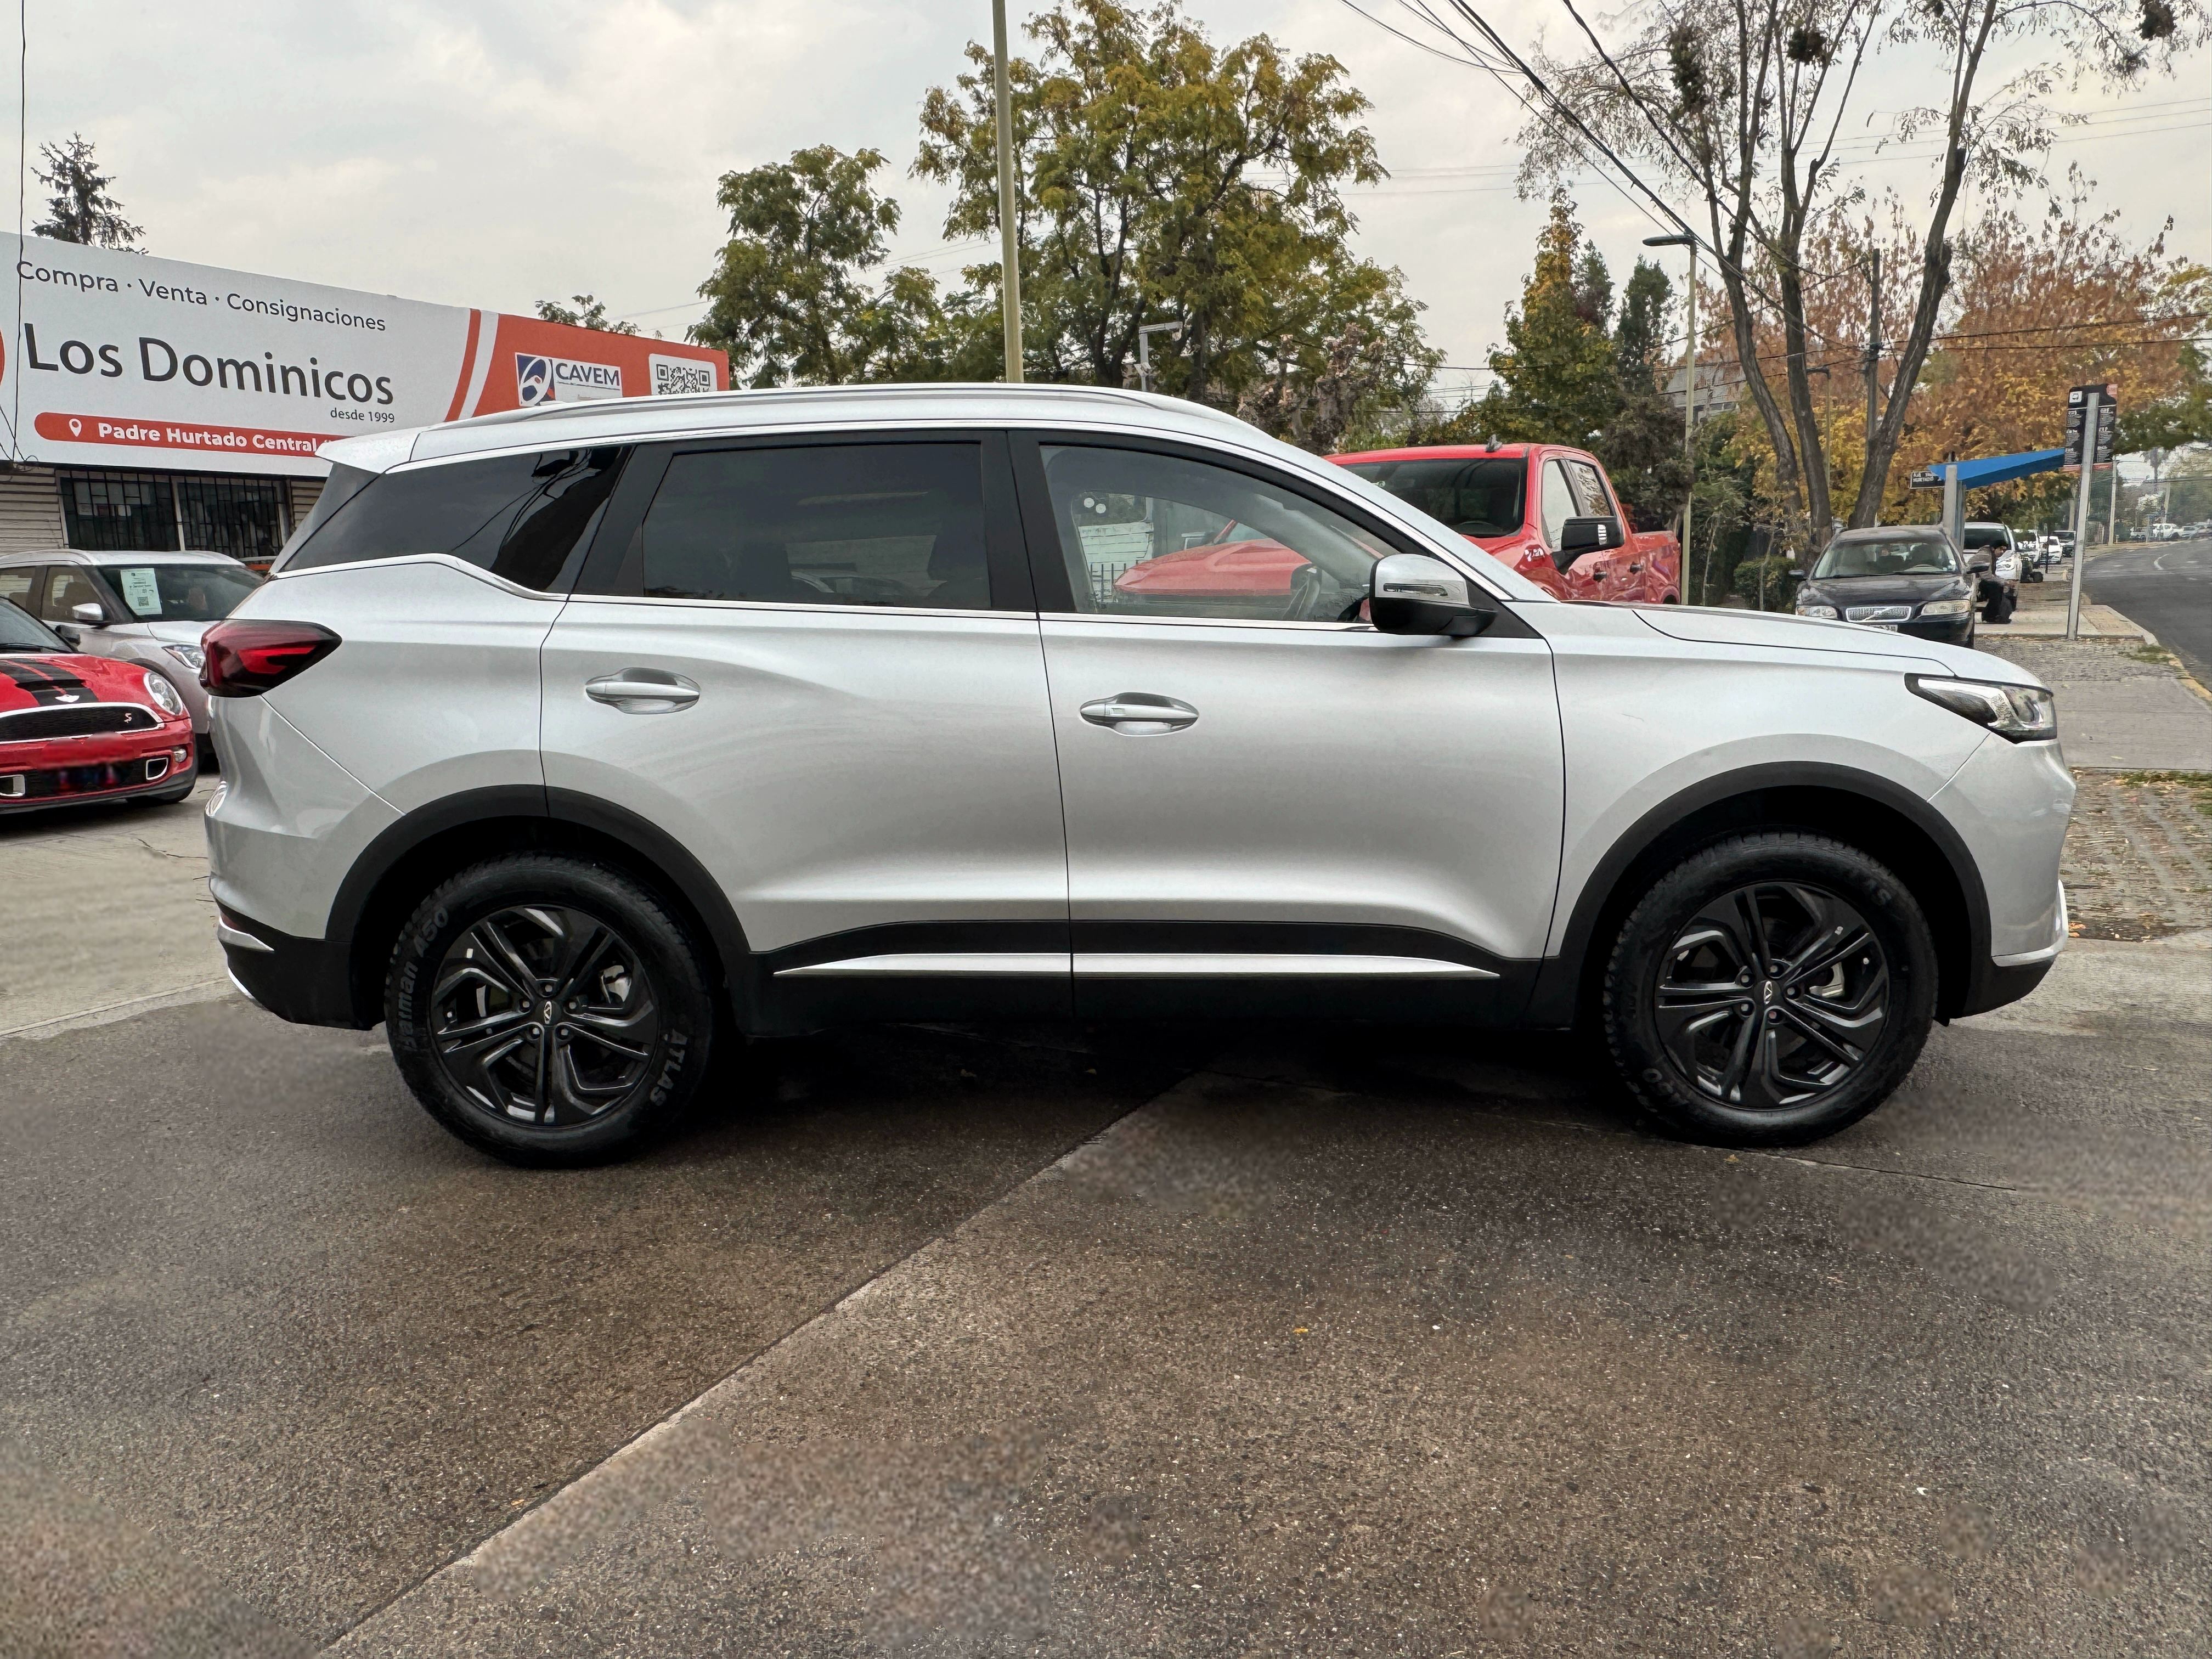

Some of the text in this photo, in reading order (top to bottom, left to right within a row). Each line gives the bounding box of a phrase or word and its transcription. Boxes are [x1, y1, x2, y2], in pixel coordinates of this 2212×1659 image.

[17, 261, 386, 331] Compra Venta Consignaciones
[24, 322, 393, 405] Los Dominicos
[555, 362, 620, 386] CAVEM
[98, 422, 317, 452] Padre Hurtado Central
[330, 407, 394, 423] desde 1999
[650, 1028, 689, 1107] ATLAS
